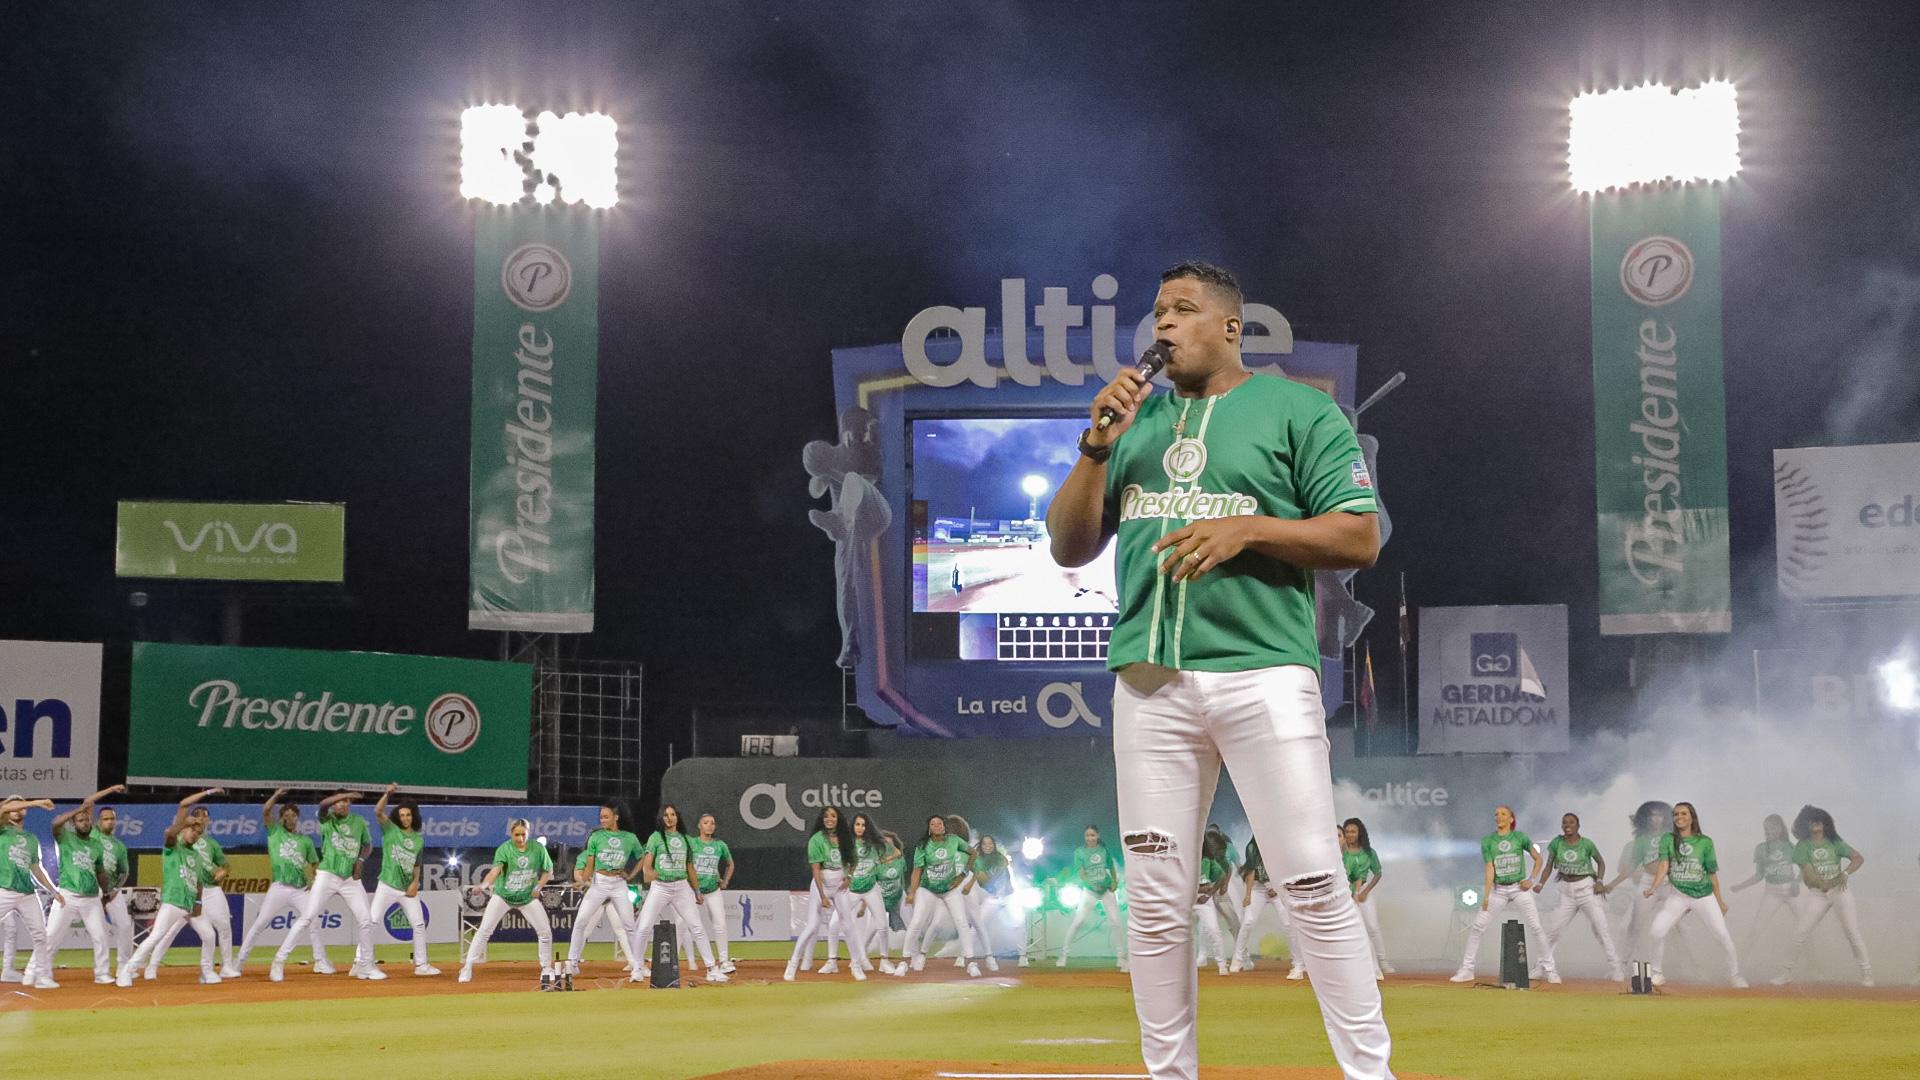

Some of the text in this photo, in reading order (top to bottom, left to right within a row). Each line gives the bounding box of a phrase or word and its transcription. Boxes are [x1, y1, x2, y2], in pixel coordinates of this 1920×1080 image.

[496, 322, 554, 584] Presidente
[1624, 319, 1684, 586] Presidente
[1120, 484, 1258, 521] Presidente
[1859, 494, 1920, 528] ed
[1003, 617, 1010, 627] 1
[1019, 617, 1028, 627] 2
[1036, 617, 1044, 627] 3
[1052, 617, 1061, 627] 4
[1102, 617, 1109, 627] 7
[189, 679, 416, 736] Presidente
[957, 697, 984, 714] La
[991, 696, 1027, 714] red
[1432, 706, 1558, 726] METALDOM
[0, 698, 72, 758] n
[0, 766, 27, 780] tas
[33, 769, 54, 780] en
[802, 784, 882, 808] altice
[1363, 782, 1449, 806] altice
[505, 816, 586, 836] btcris
[222, 874, 270, 892] irena
[501, 911, 533, 930] Blu
